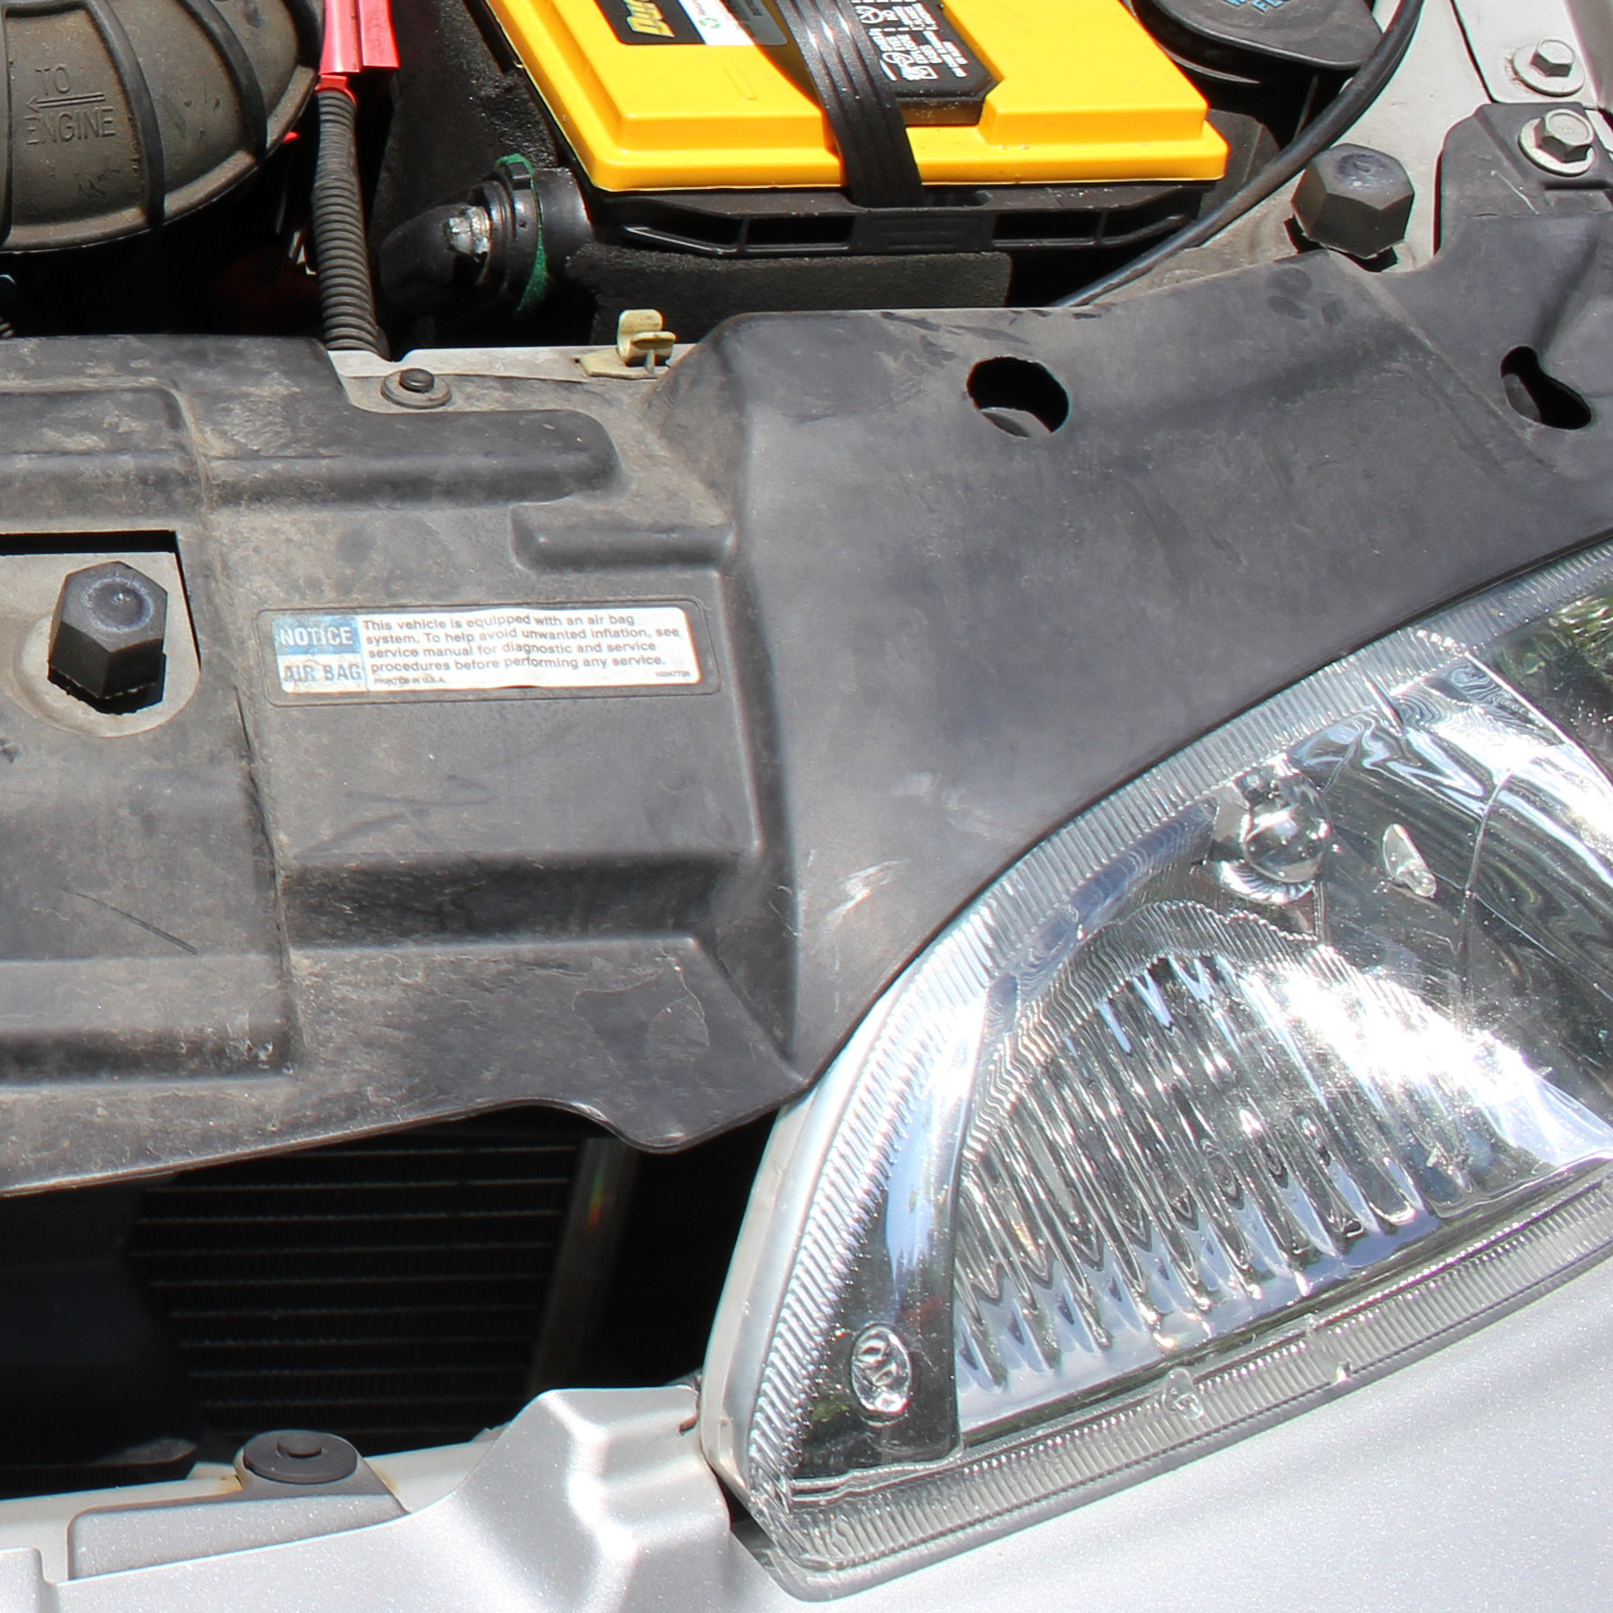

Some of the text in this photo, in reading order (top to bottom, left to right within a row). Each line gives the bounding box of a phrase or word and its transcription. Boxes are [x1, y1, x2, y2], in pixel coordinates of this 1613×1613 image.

[35, 64, 71, 96] TO
[24, 106, 116, 146] ENGINE
[362, 614, 635, 631] This vehicle is equipped with an air bag
[280, 627, 353, 646] NOTICE
[366, 627, 680, 646] system. To help avoid unwanted inflation, see
[368, 642, 657, 658] service manual for diagnostic and service
[283, 664, 362, 682] AIR BAG
[370, 655, 666, 675] procedures before performing any service.
